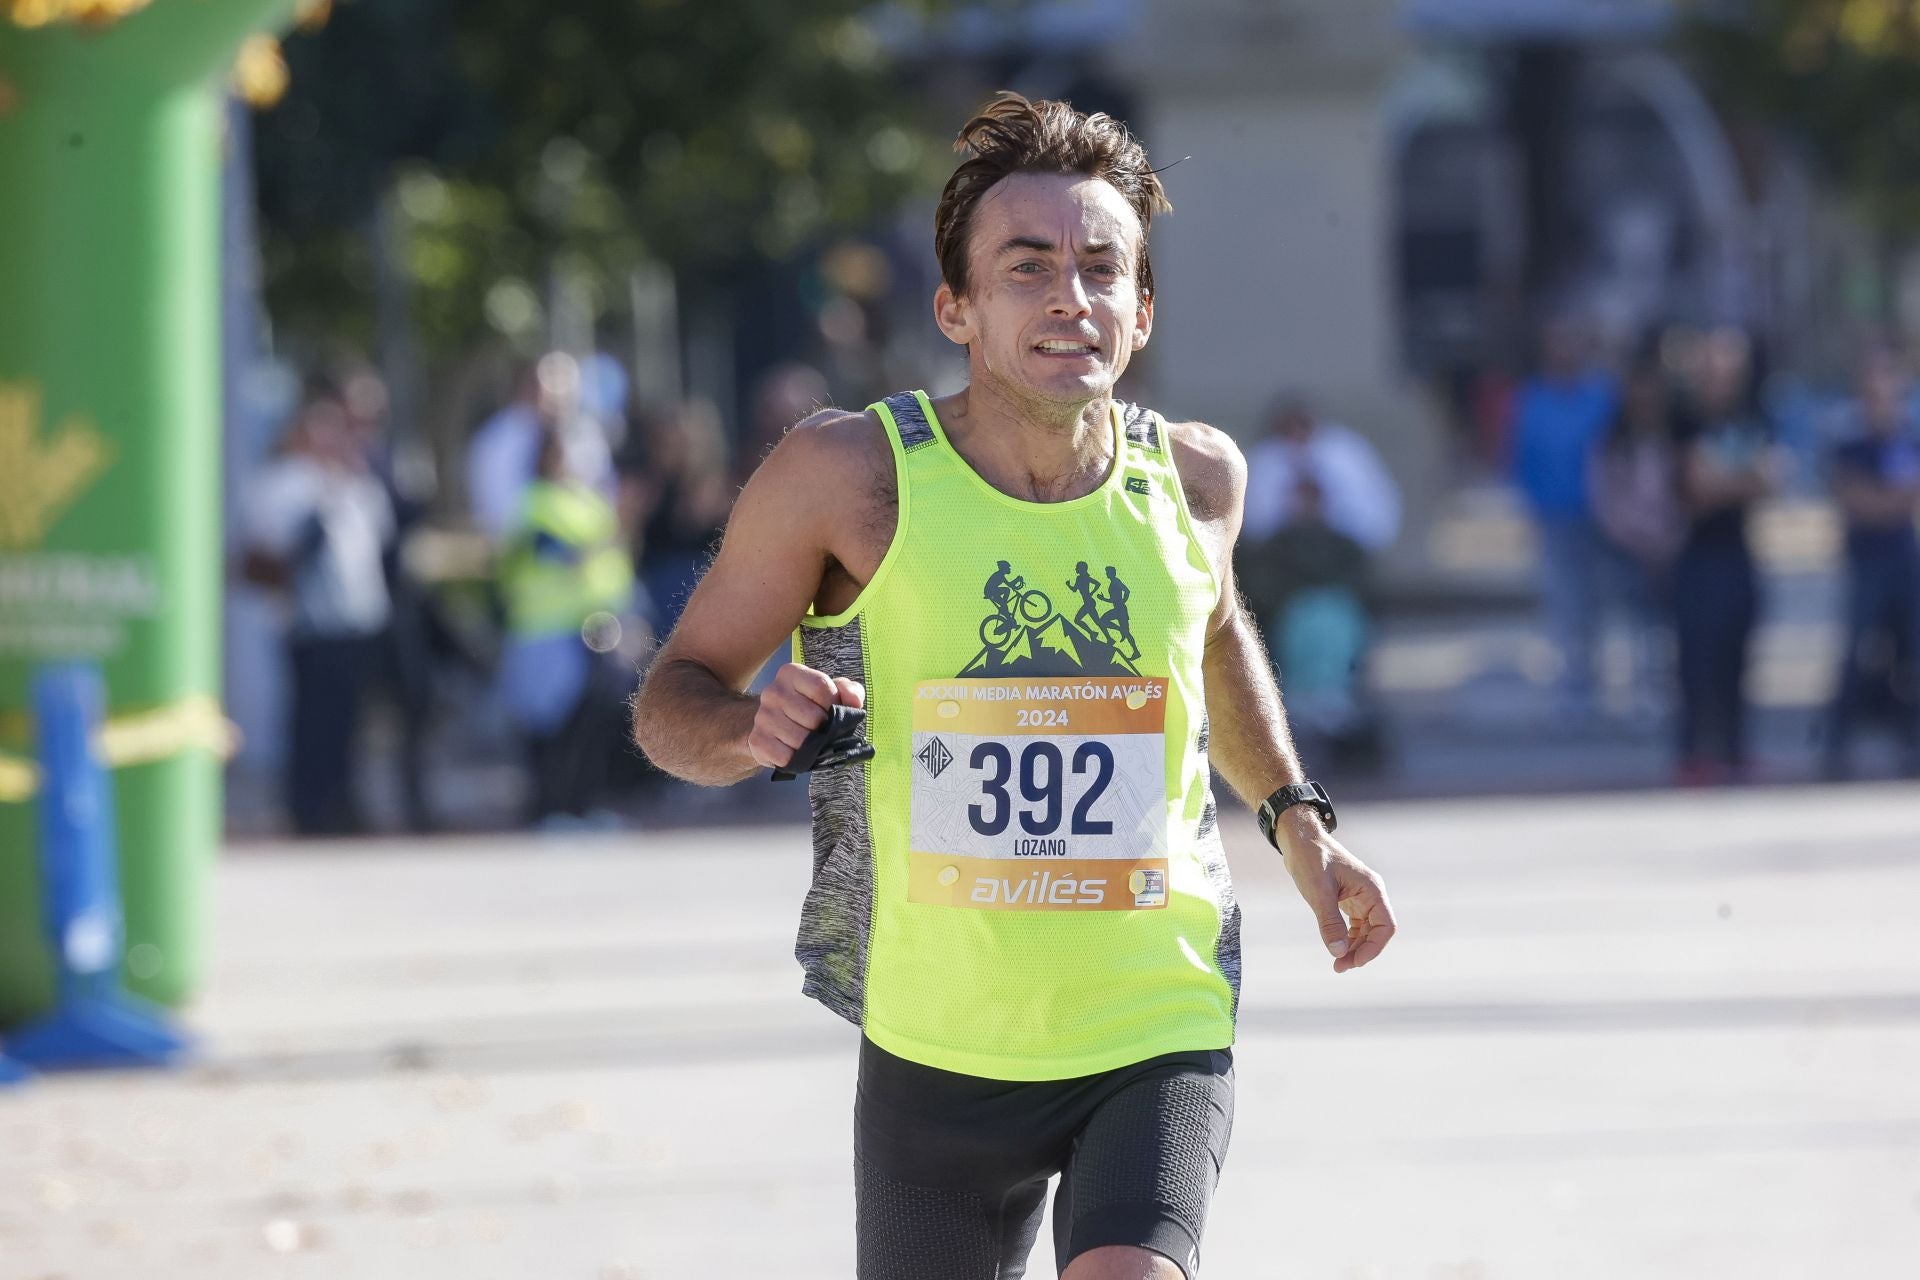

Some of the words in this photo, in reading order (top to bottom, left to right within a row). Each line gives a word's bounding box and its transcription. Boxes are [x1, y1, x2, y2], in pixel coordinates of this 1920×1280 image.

[917, 686, 968, 700] XXXIII
[973, 686, 1021, 700] MEDIA
[1026, 681, 1107, 700] MARATÓN
[1111, 681, 1162, 699] AVÉS
[1016, 709, 1069, 727] 2024
[968, 741, 1115, 836] 392
[1014, 839, 1066, 856] LOZANO
[971, 871, 1107, 904] avilés
